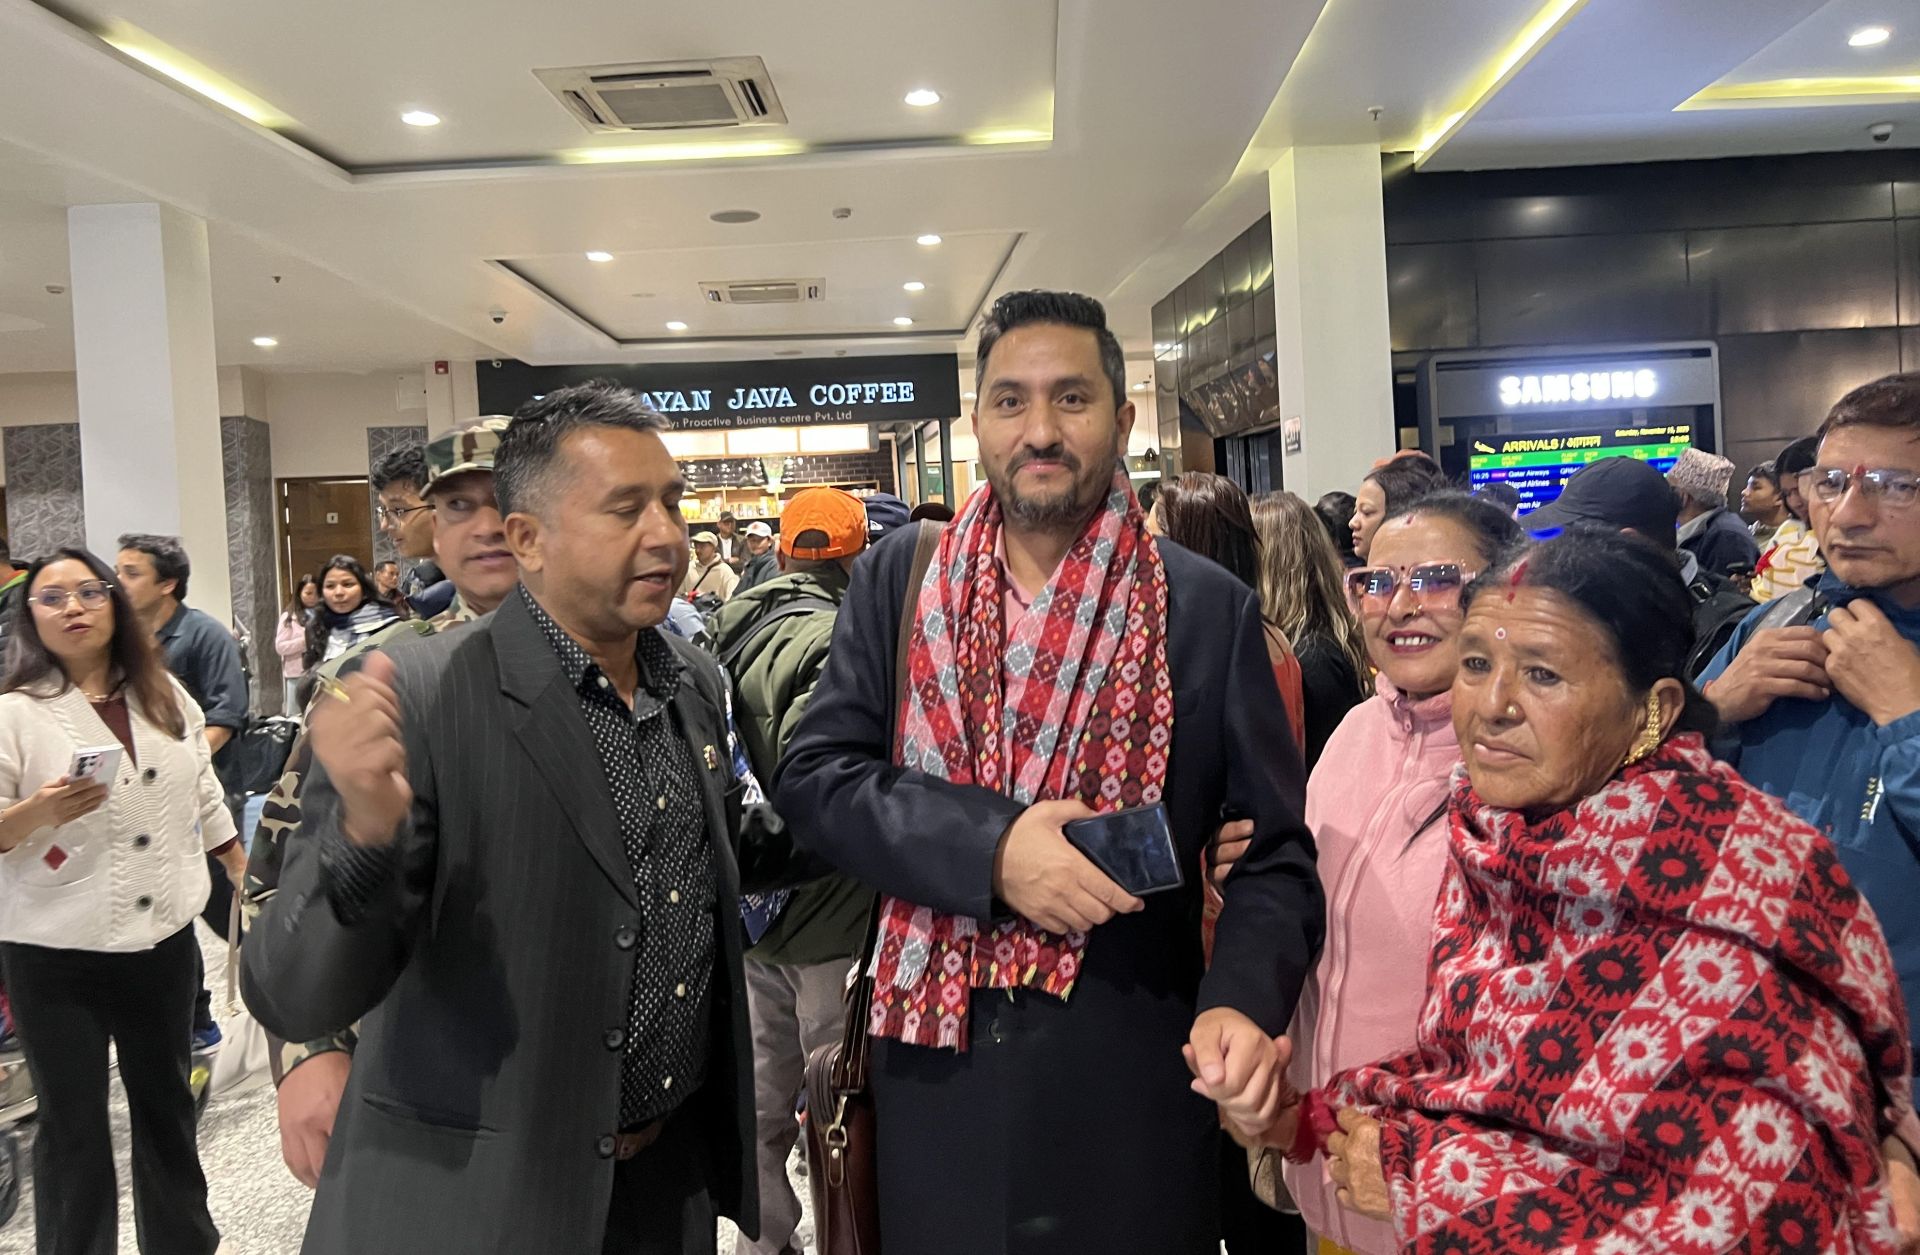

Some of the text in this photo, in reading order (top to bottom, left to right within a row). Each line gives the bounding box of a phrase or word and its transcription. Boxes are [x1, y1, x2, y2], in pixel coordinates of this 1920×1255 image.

[1499, 368, 1656, 405] SAMSUNG
[727, 387, 797, 410] JAVA
[809, 381, 915, 406] COFFEE
[683, 417, 731, 428] Proactive
[737, 415, 777, 426] Business
[780, 412, 811, 423] centre
[815, 410, 834, 421] Pvt.
[836, 410, 852, 420] Ltd
[1502, 438, 1559, 453] ARRIVALS
[1508, 470, 1526, 478] Qatar
[1526, 469, 1550, 477] Airways
[1527, 479, 1550, 488] Airlines
[1519, 491, 1534, 499] ndia
